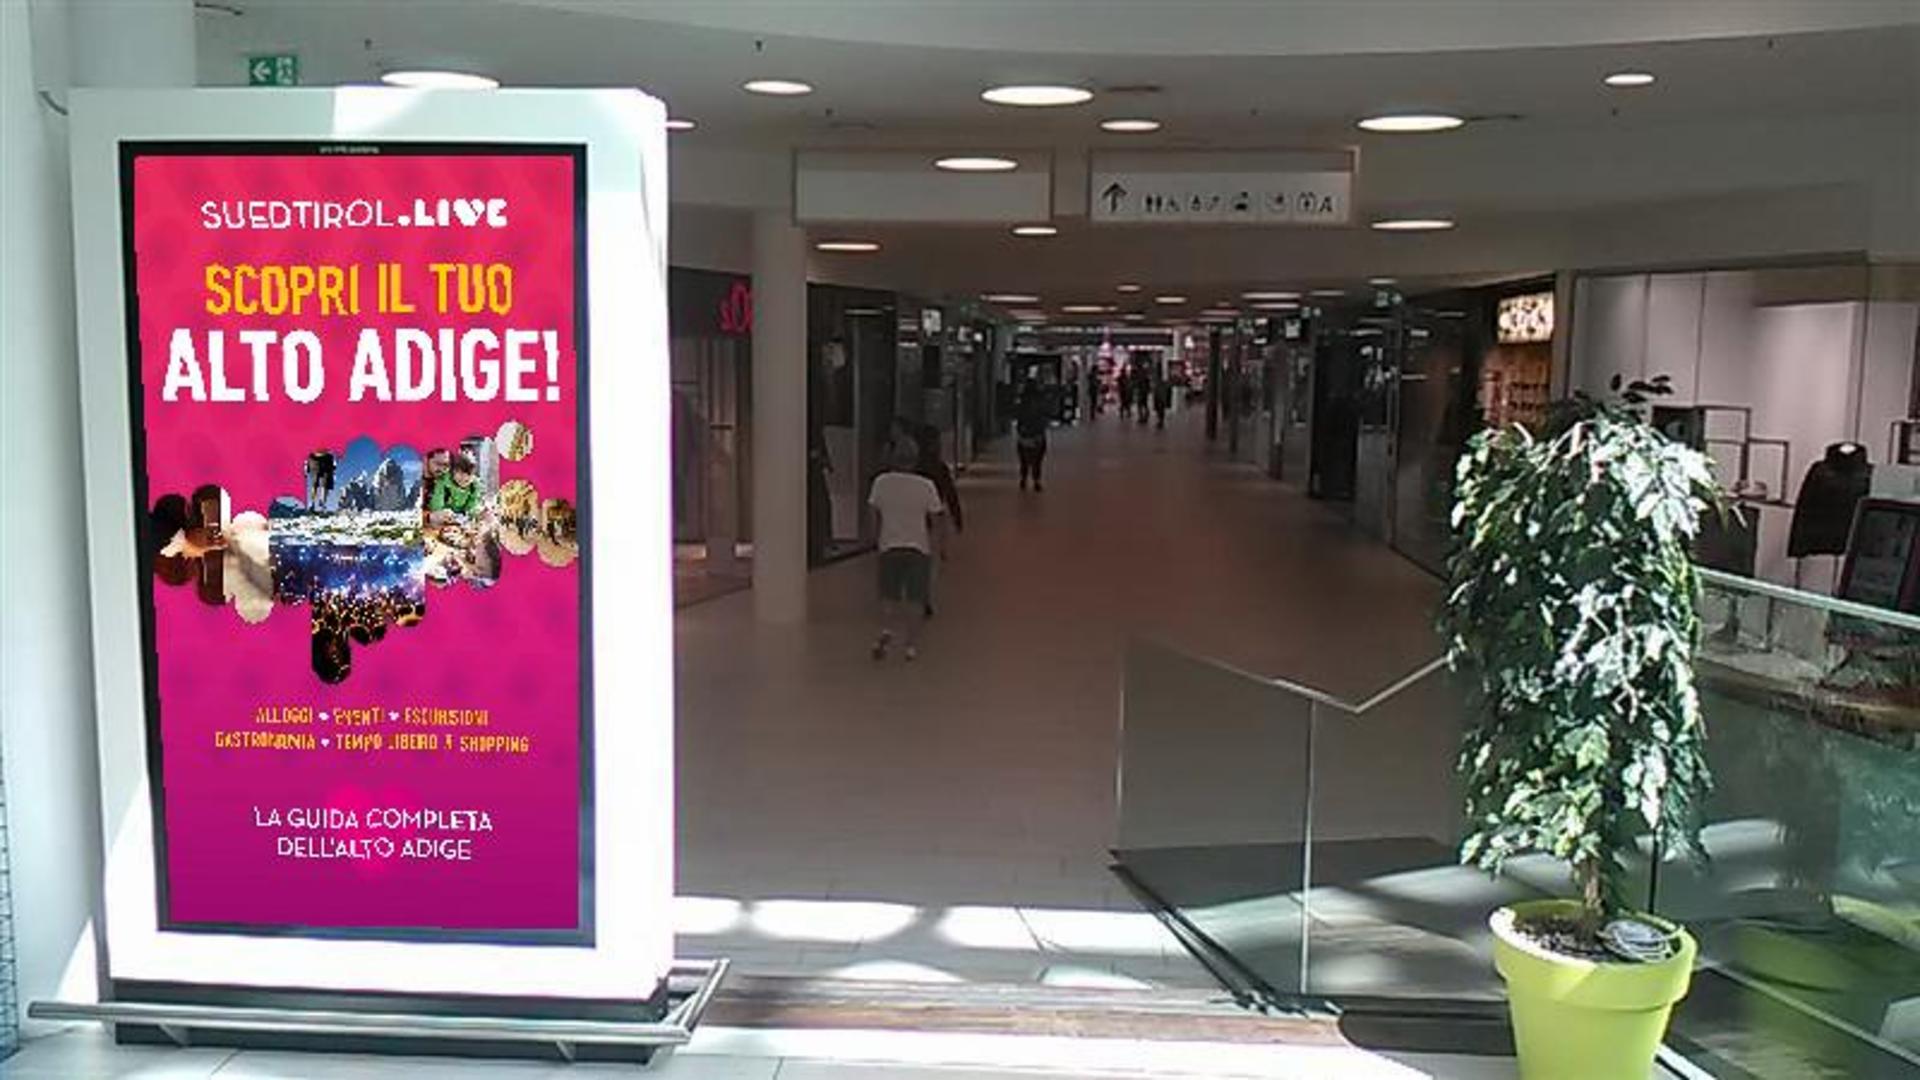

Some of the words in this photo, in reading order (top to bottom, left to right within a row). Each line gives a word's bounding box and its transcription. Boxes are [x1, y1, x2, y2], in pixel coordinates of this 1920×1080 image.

[201, 198, 508, 230] SUEDTIROL.LIVE
[204, 263, 360, 316] SCOPRI
[378, 266, 416, 312] IL
[429, 263, 513, 315] TUO
[163, 328, 325, 403] ALTO
[348, 328, 561, 402] ADIGE!
[256, 707, 313, 724] ALLOGGI
[215, 732, 316, 751] GASTRONOMIA
[335, 733, 383, 752] TEMPO
[459, 735, 529, 753] SHOPPING
[254, 806, 282, 828] LA
[287, 807, 359, 830] GUIDA
[366, 807, 493, 832] COMPLETA
[277, 836, 395, 860] DELL'ALTO
[400, 839, 472, 860] ADIGE
